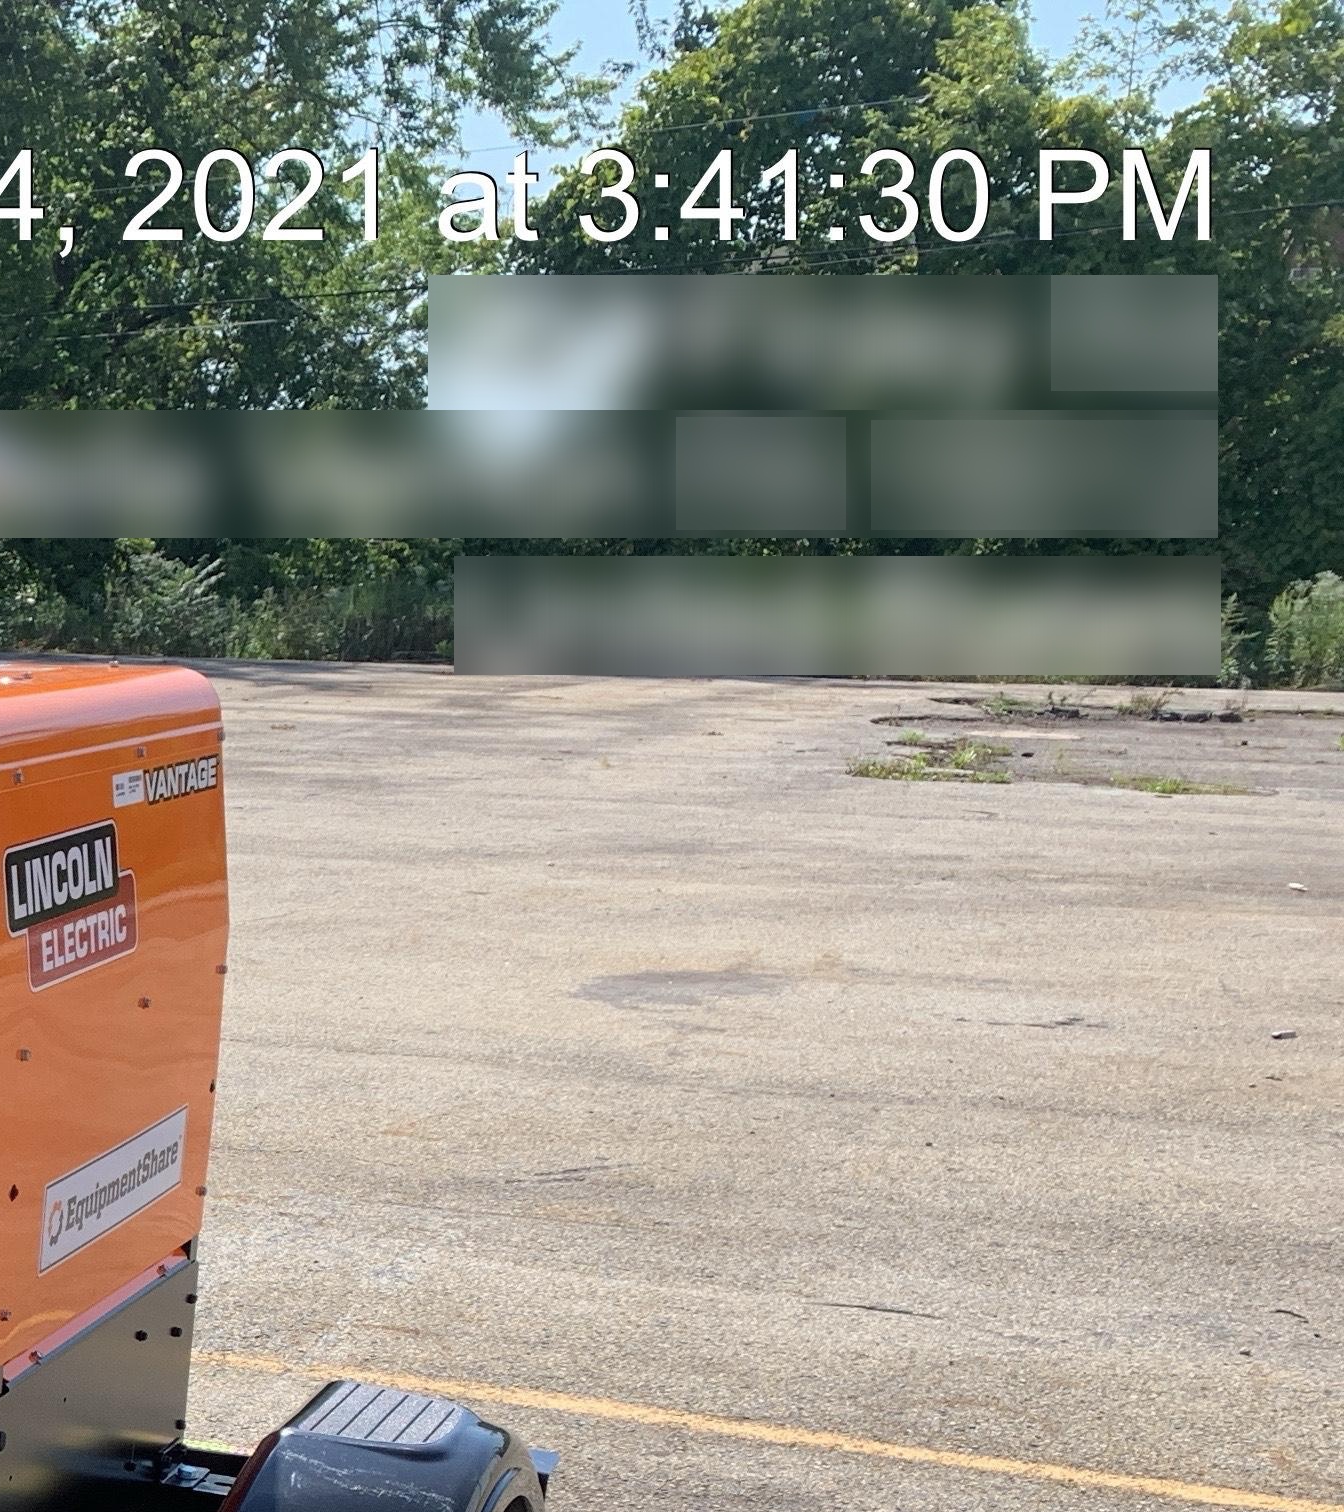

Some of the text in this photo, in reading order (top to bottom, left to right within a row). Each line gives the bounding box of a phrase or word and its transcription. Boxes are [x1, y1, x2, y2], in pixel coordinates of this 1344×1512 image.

[144, 755, 218, 805] VANTAGE
[11, 836, 114, 920] LINCOLN
[40, 904, 128, 973] ELECTRIC
[64, 1141, 179, 1231] EquipmentShare
